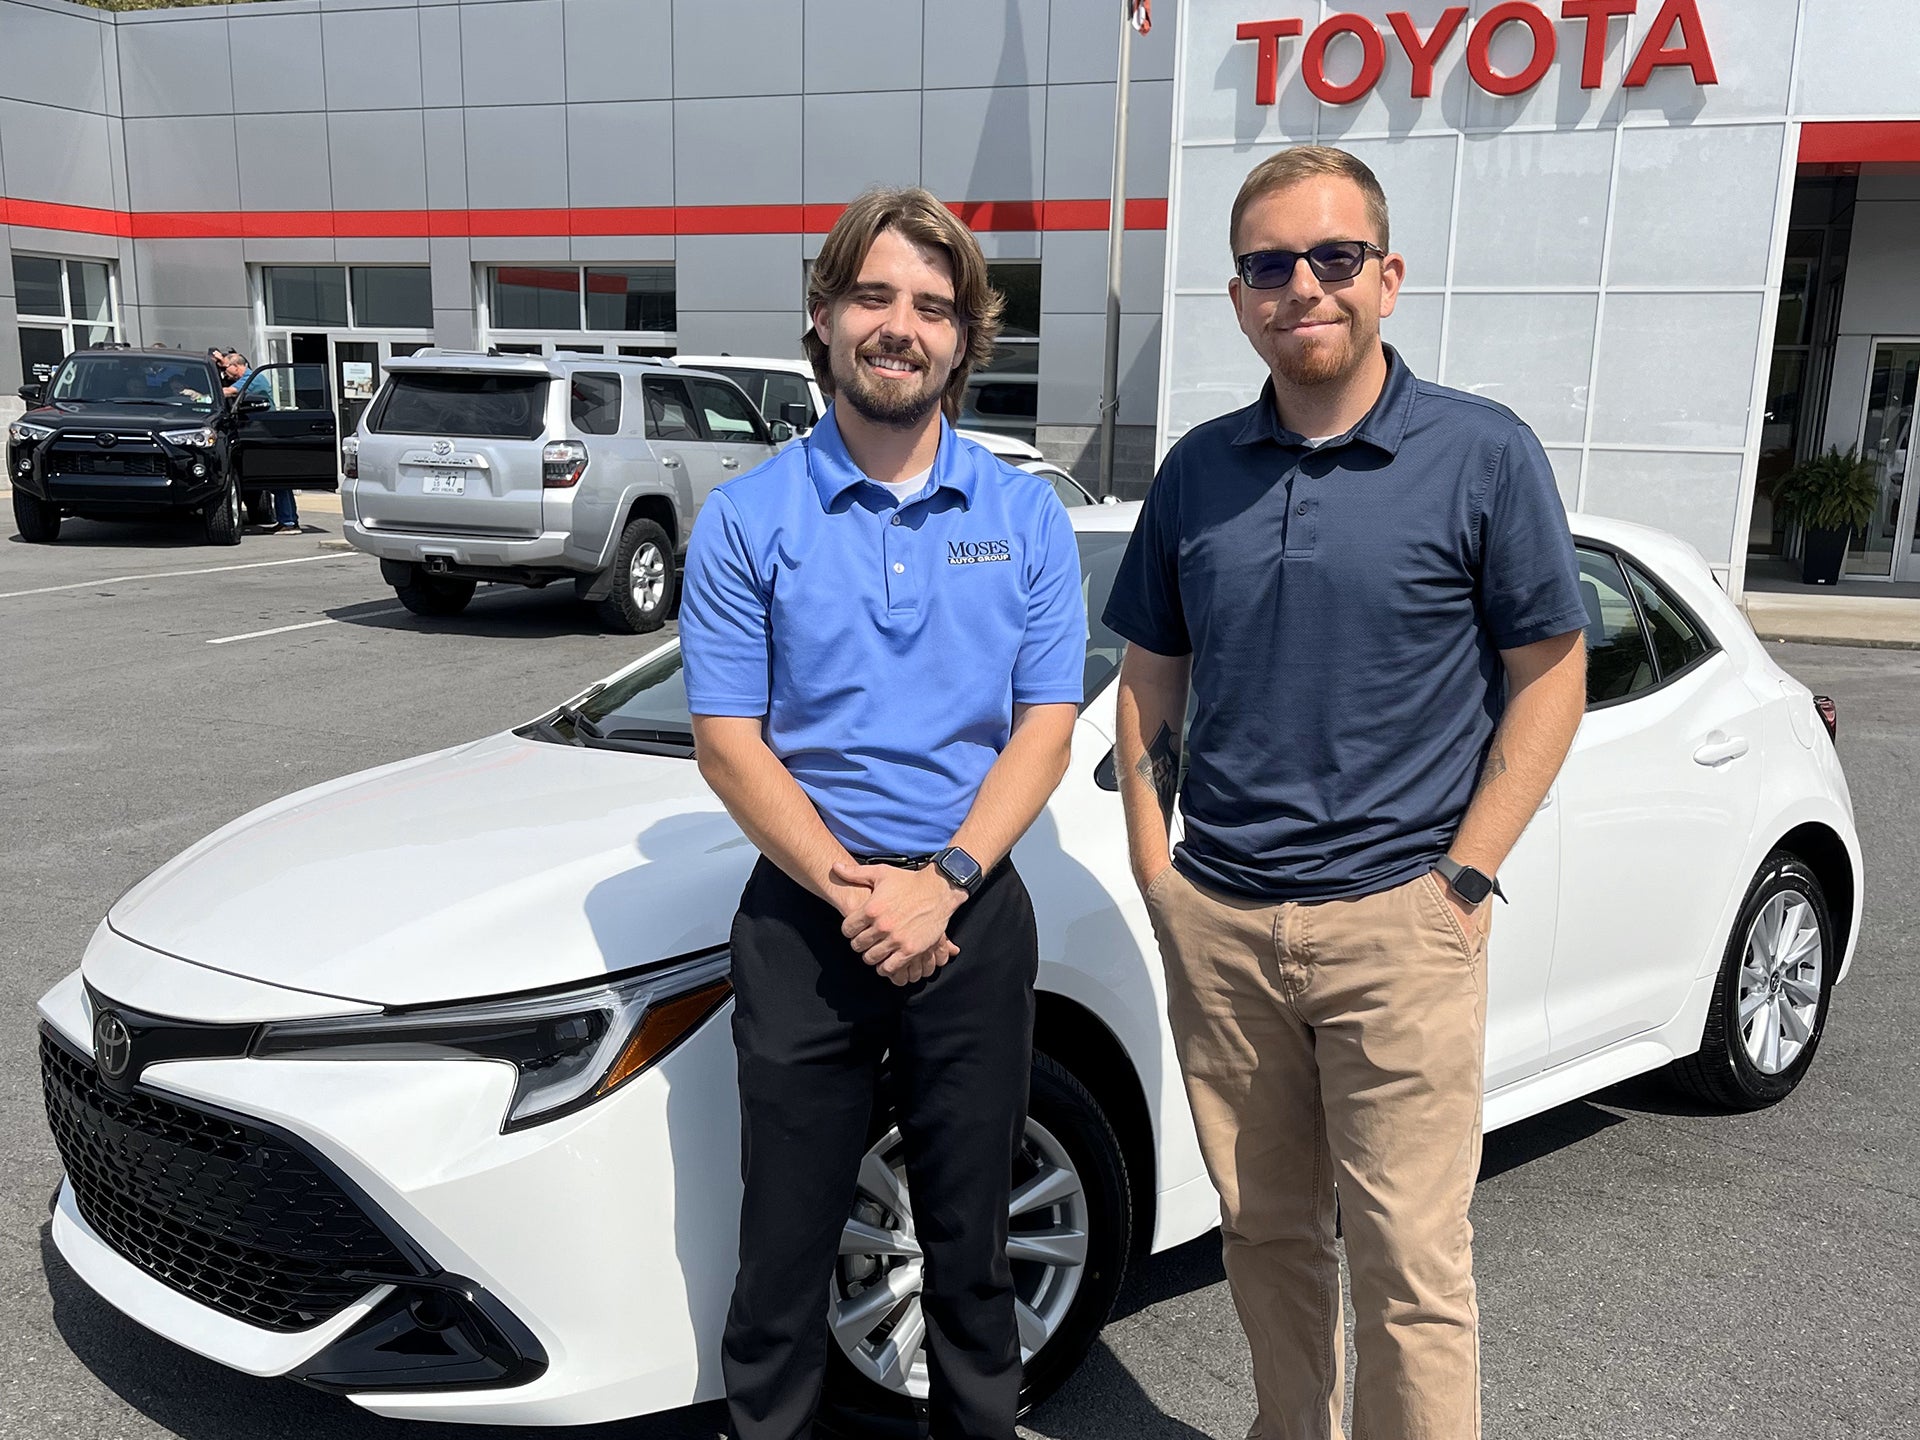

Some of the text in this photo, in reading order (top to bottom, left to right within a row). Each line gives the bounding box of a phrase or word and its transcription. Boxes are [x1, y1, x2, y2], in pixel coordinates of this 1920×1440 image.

[1236, 0, 1717, 105] TOYOTA
[445, 476, 457, 487] 47
[947, 539, 1009, 557] MOSES
[977, 554, 1009, 562] GROUP
